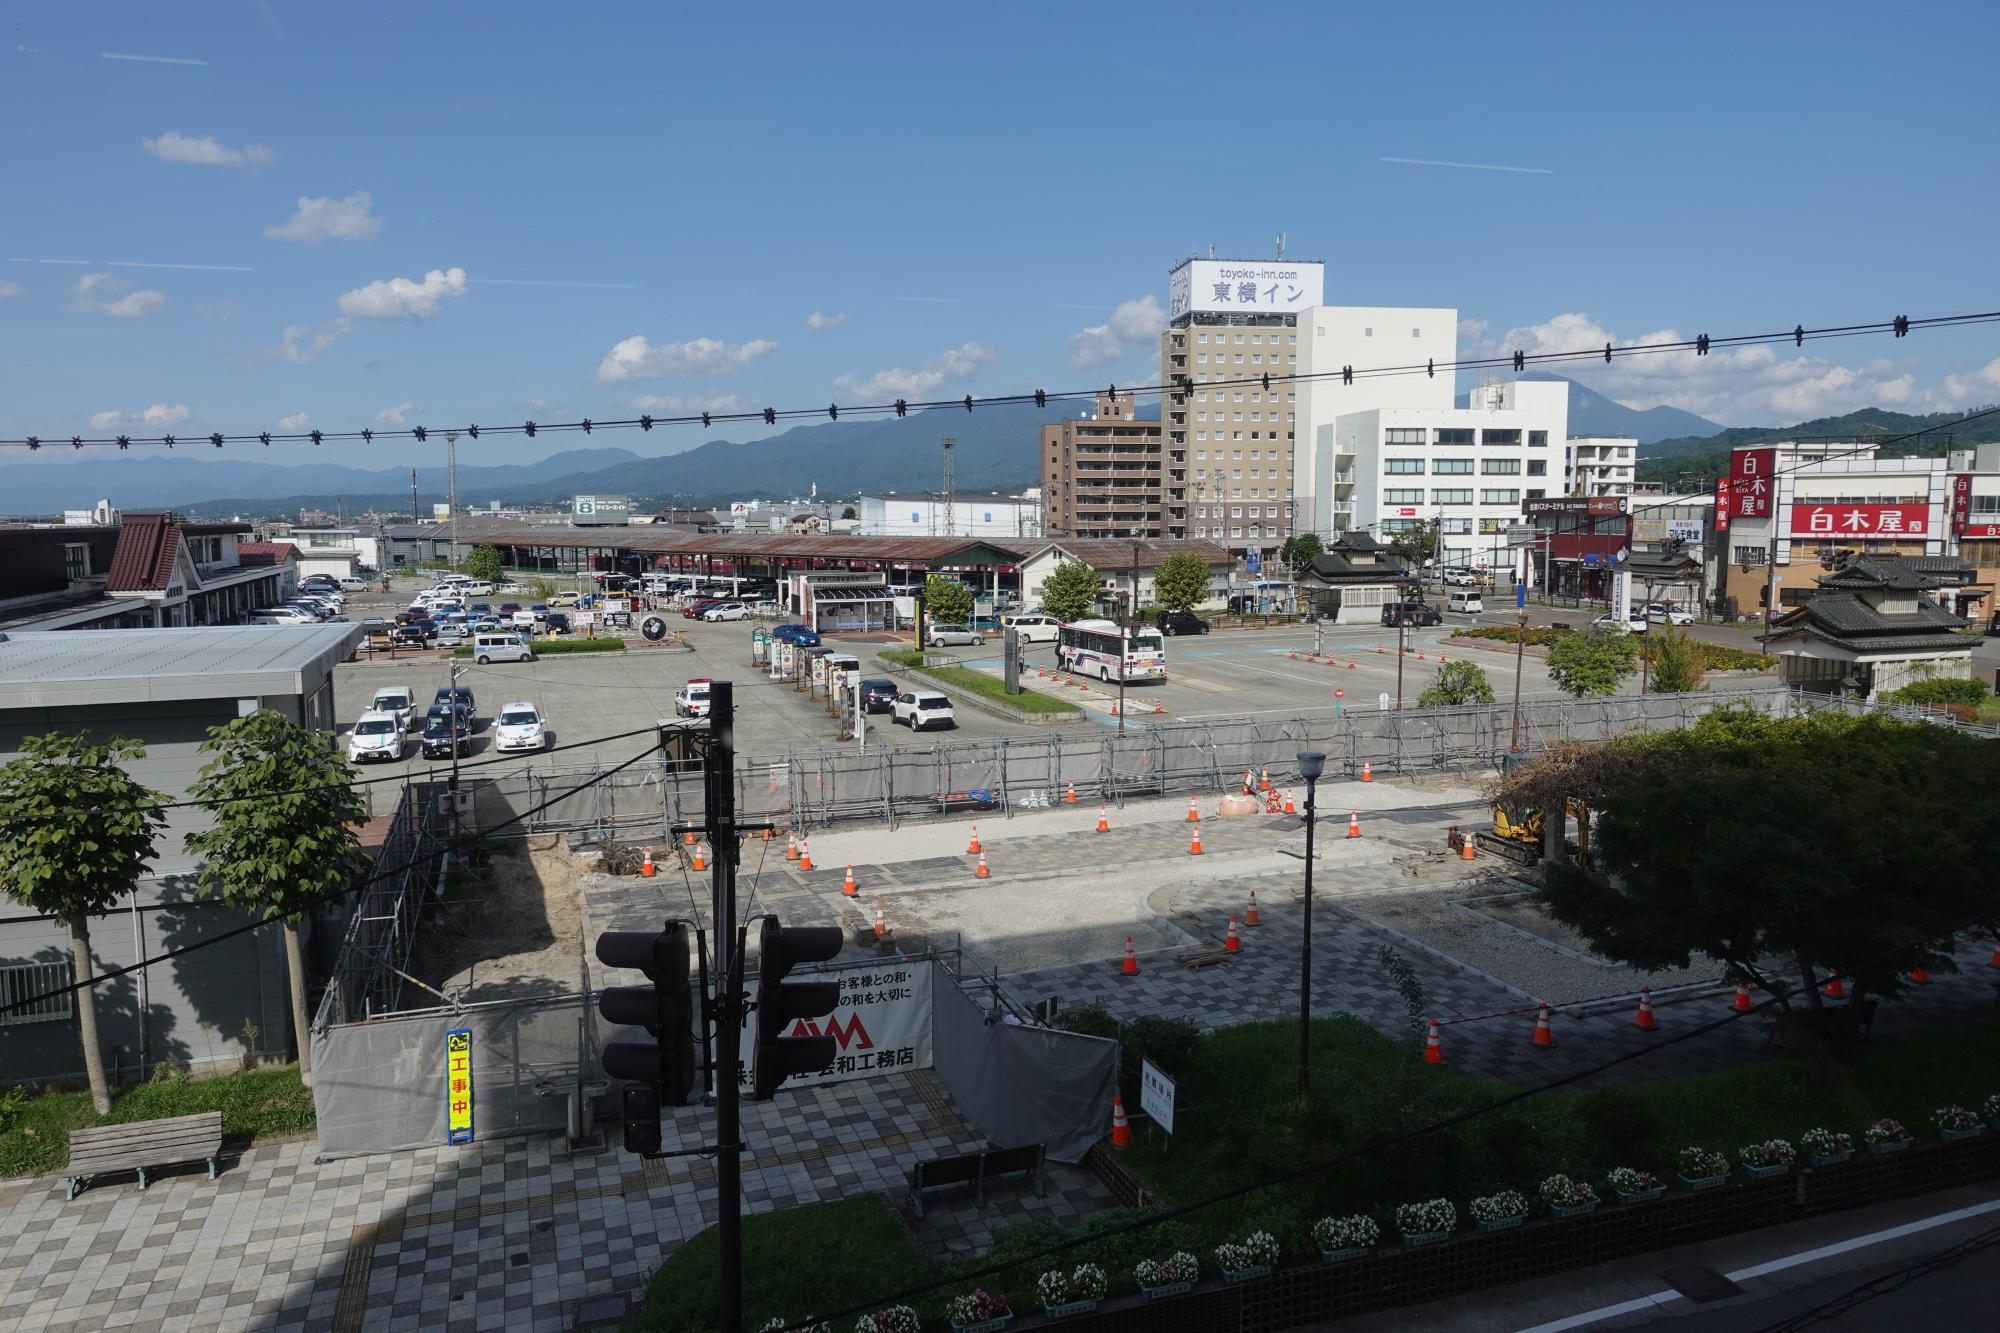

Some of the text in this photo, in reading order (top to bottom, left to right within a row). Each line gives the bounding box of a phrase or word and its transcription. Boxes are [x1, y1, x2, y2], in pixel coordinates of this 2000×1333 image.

[1219, 267, 1297, 280] toyoko-inn.com
[1212, 281, 1304, 303] 東横イン
[1740, 452, 1766, 515] 白木屋
[578, 502, 593, 513] 8
[1717, 481, 1728, 521] 白木屋
[1955, 478, 1967, 522] 白木屋
[1810, 507, 1904, 532] 白木屋
[451, 1057, 467, 1114] 工事中
